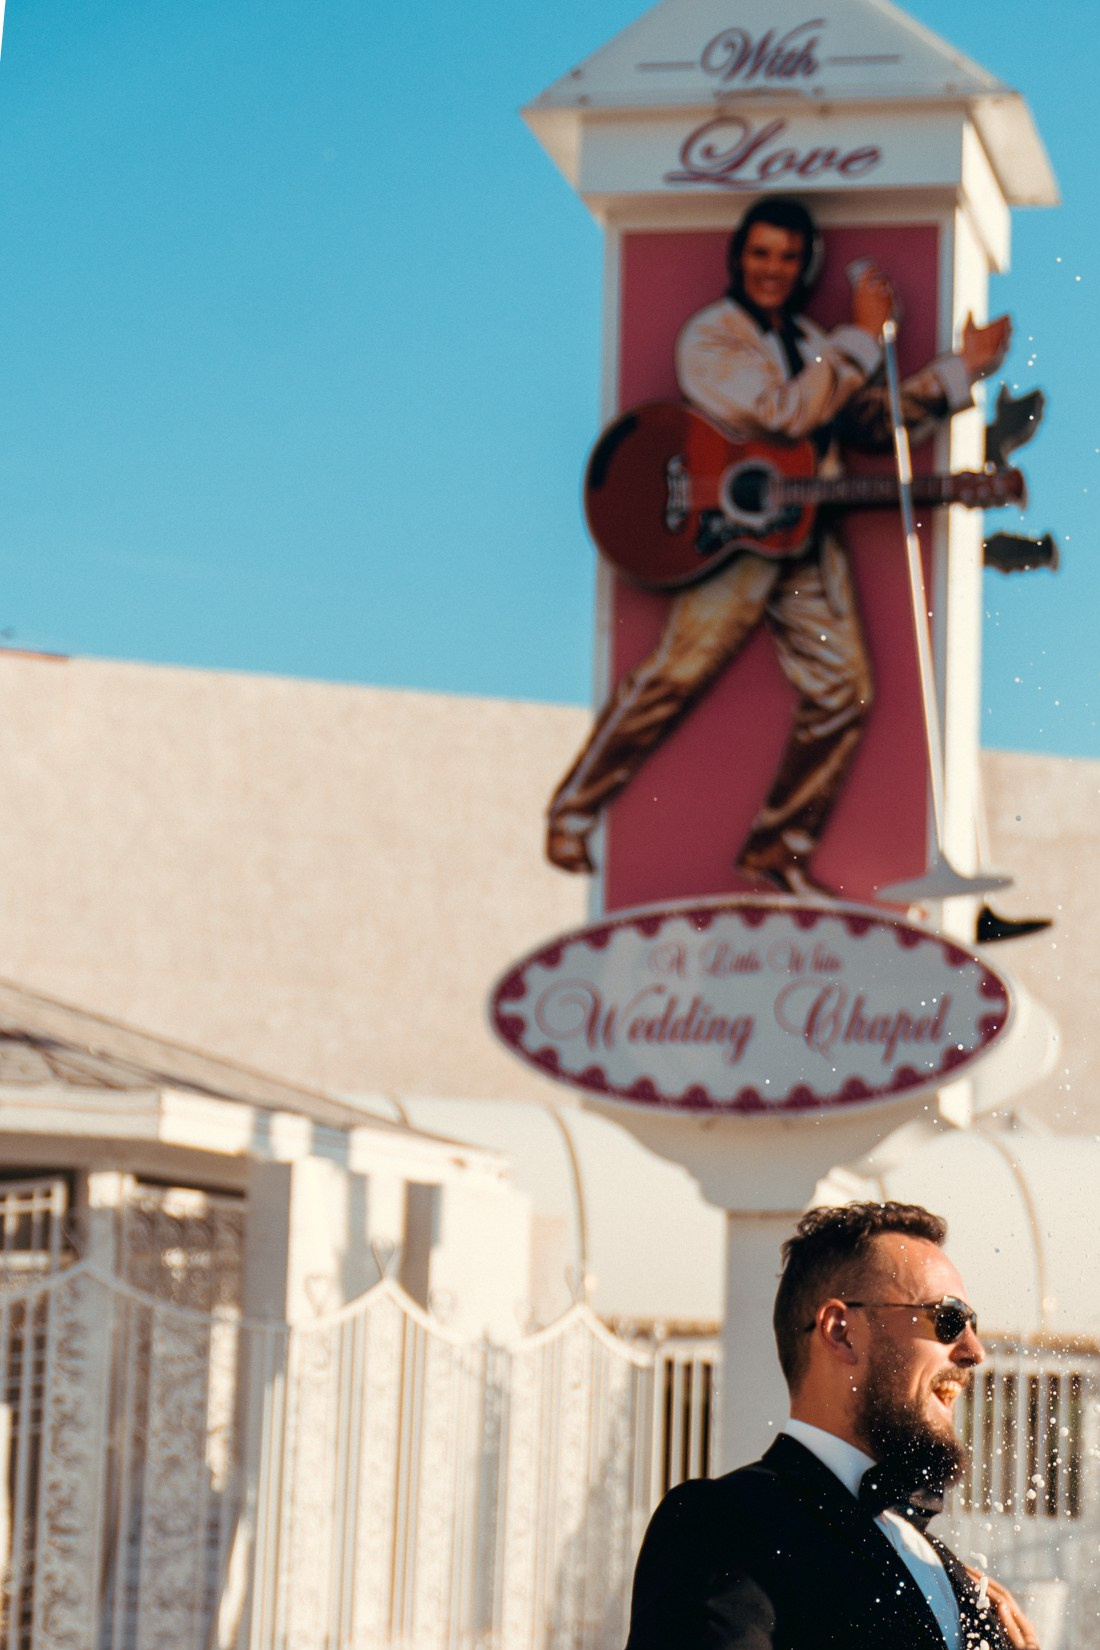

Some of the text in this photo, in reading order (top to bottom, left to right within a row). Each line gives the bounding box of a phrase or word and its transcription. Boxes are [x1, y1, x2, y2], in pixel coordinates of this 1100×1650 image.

[700, 18, 826, 83] With
[662, 116, 882, 190] Love
[534, 977, 952, 1066] Wedding Chapel
